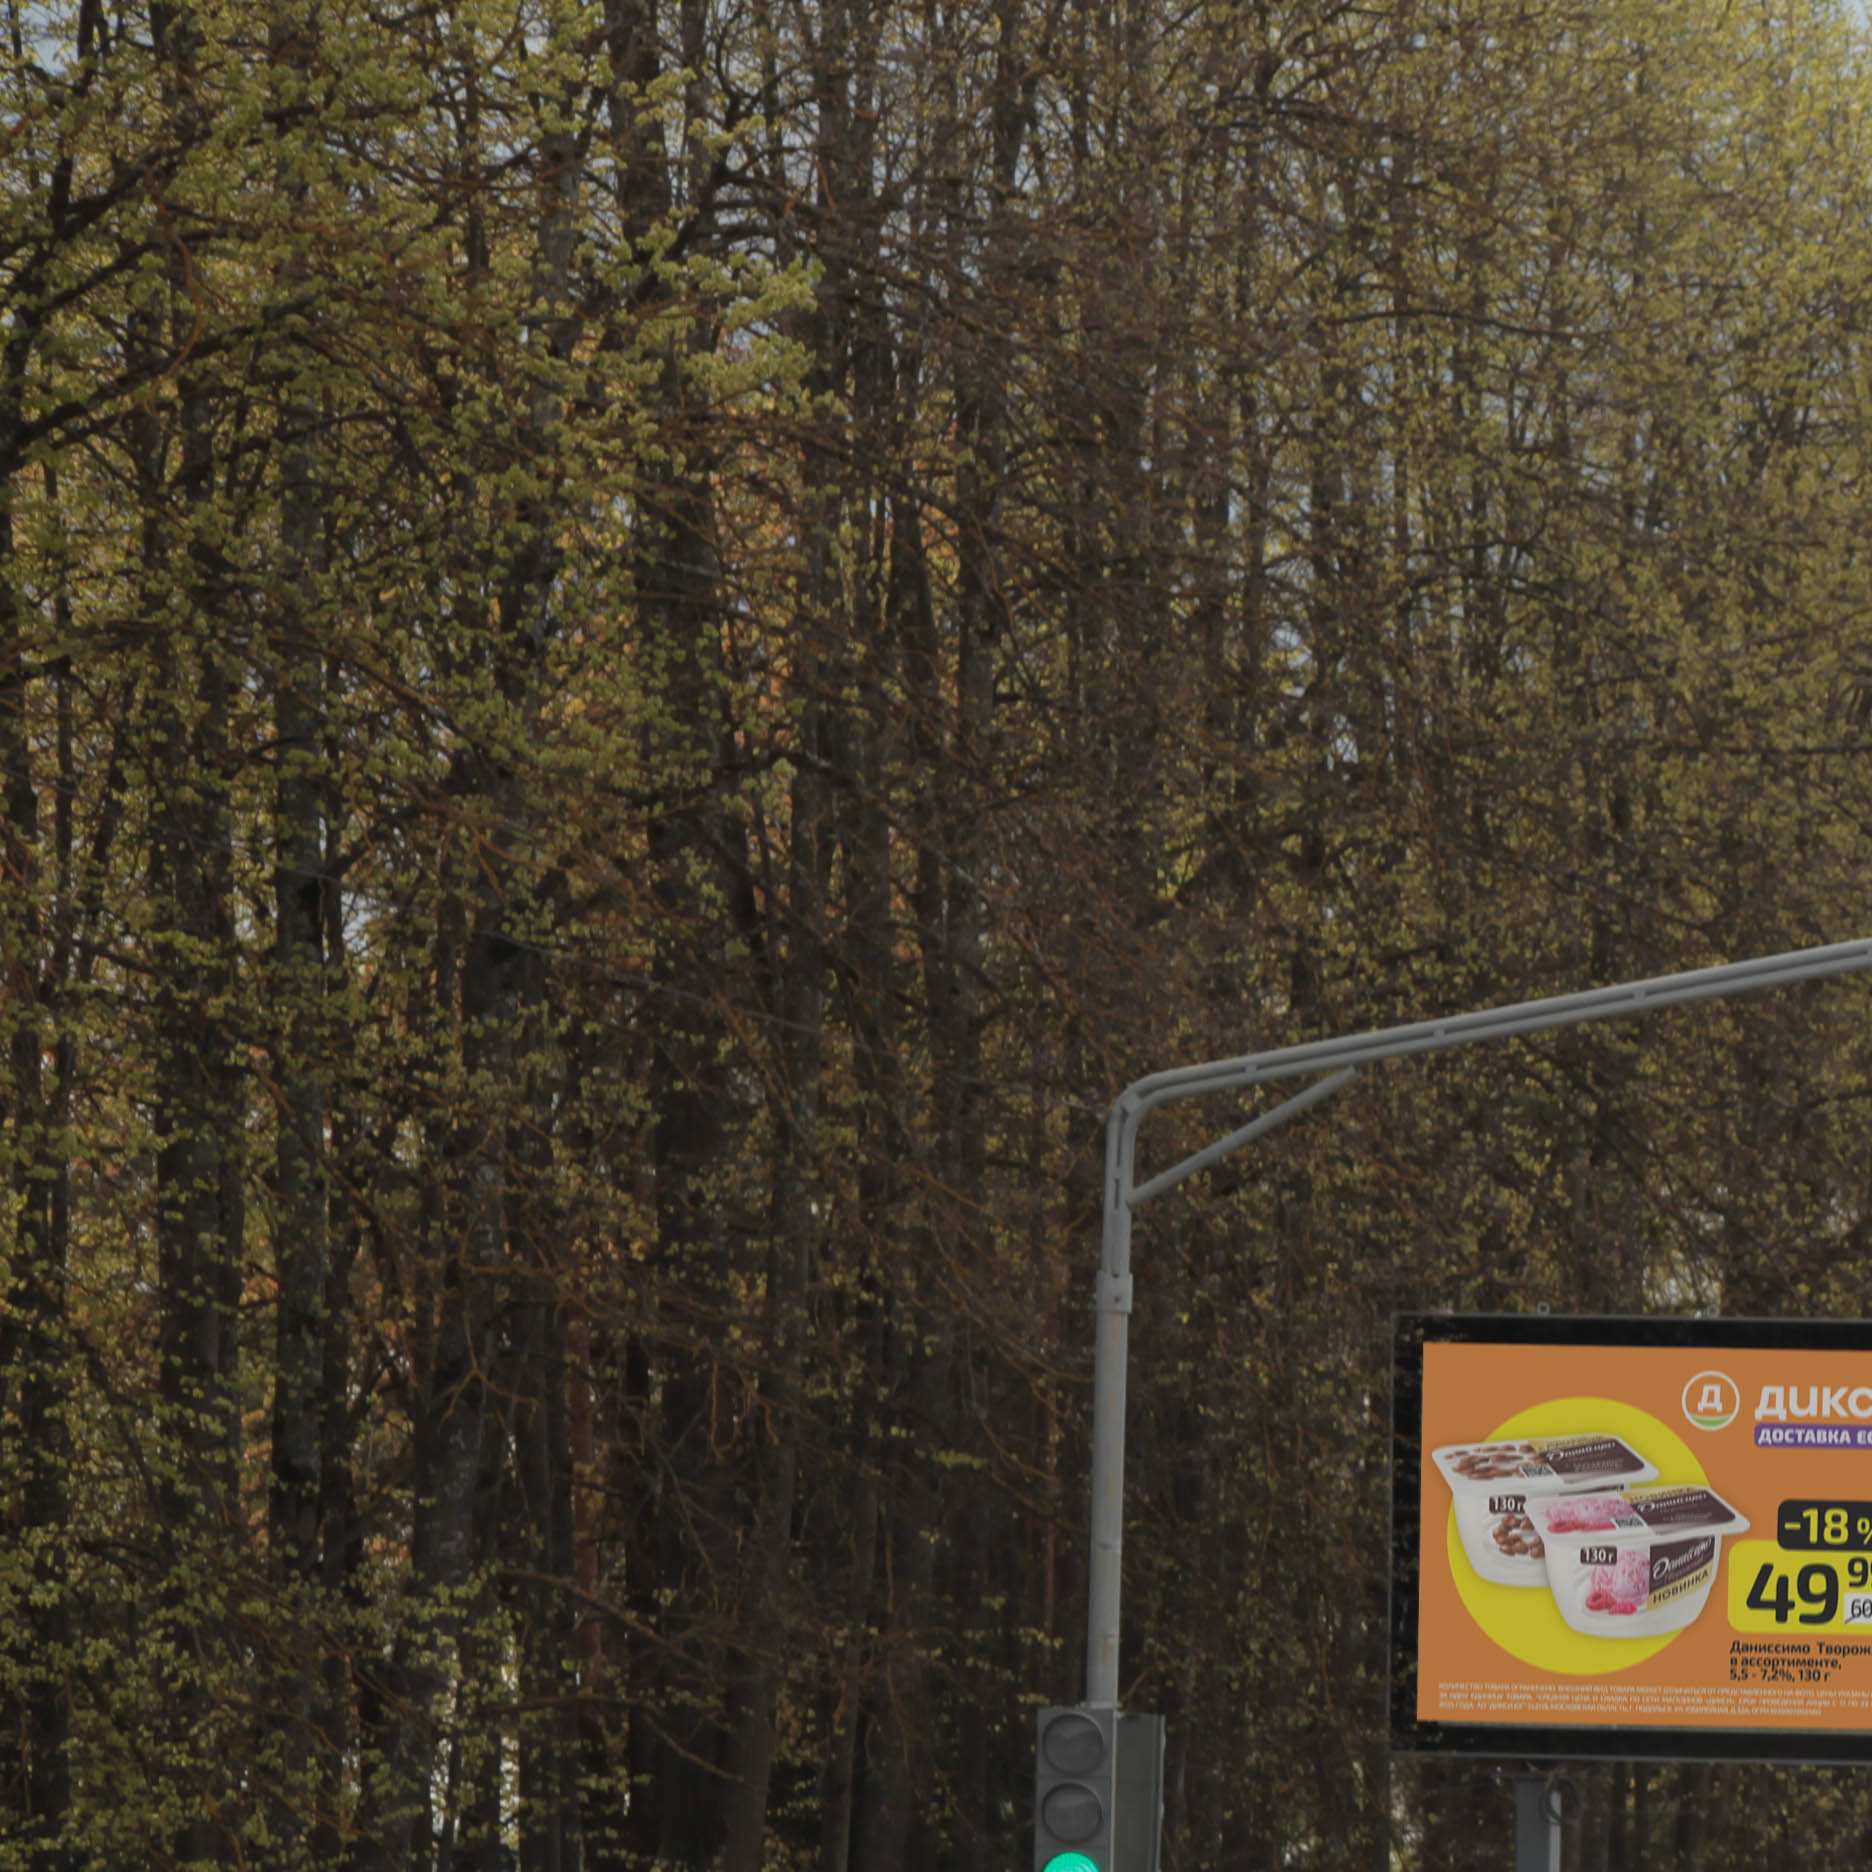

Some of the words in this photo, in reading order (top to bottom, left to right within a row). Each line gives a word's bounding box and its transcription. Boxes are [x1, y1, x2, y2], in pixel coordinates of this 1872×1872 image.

[1757, 1427, 1851, 1445] ДОСТАВКА
[1494, 1497, 1516, 1511] 130
[1784, 1507, 1849, 1545] -18
[1585, 1549, 1607, 1562] 130
[1653, 1568, 1709, 1605] НОВИНКА
[1745, 1562, 1840, 1626] 49
[1729, 1639, 1811, 1655] Даниссимо
[1729, 1657, 1738, 1667] в
[1740, 1656, 1842, 1672] ассортименте,
[1729, 1668, 1749, 1682] 5,5
[1798, 1669, 1821, 1682] 130
